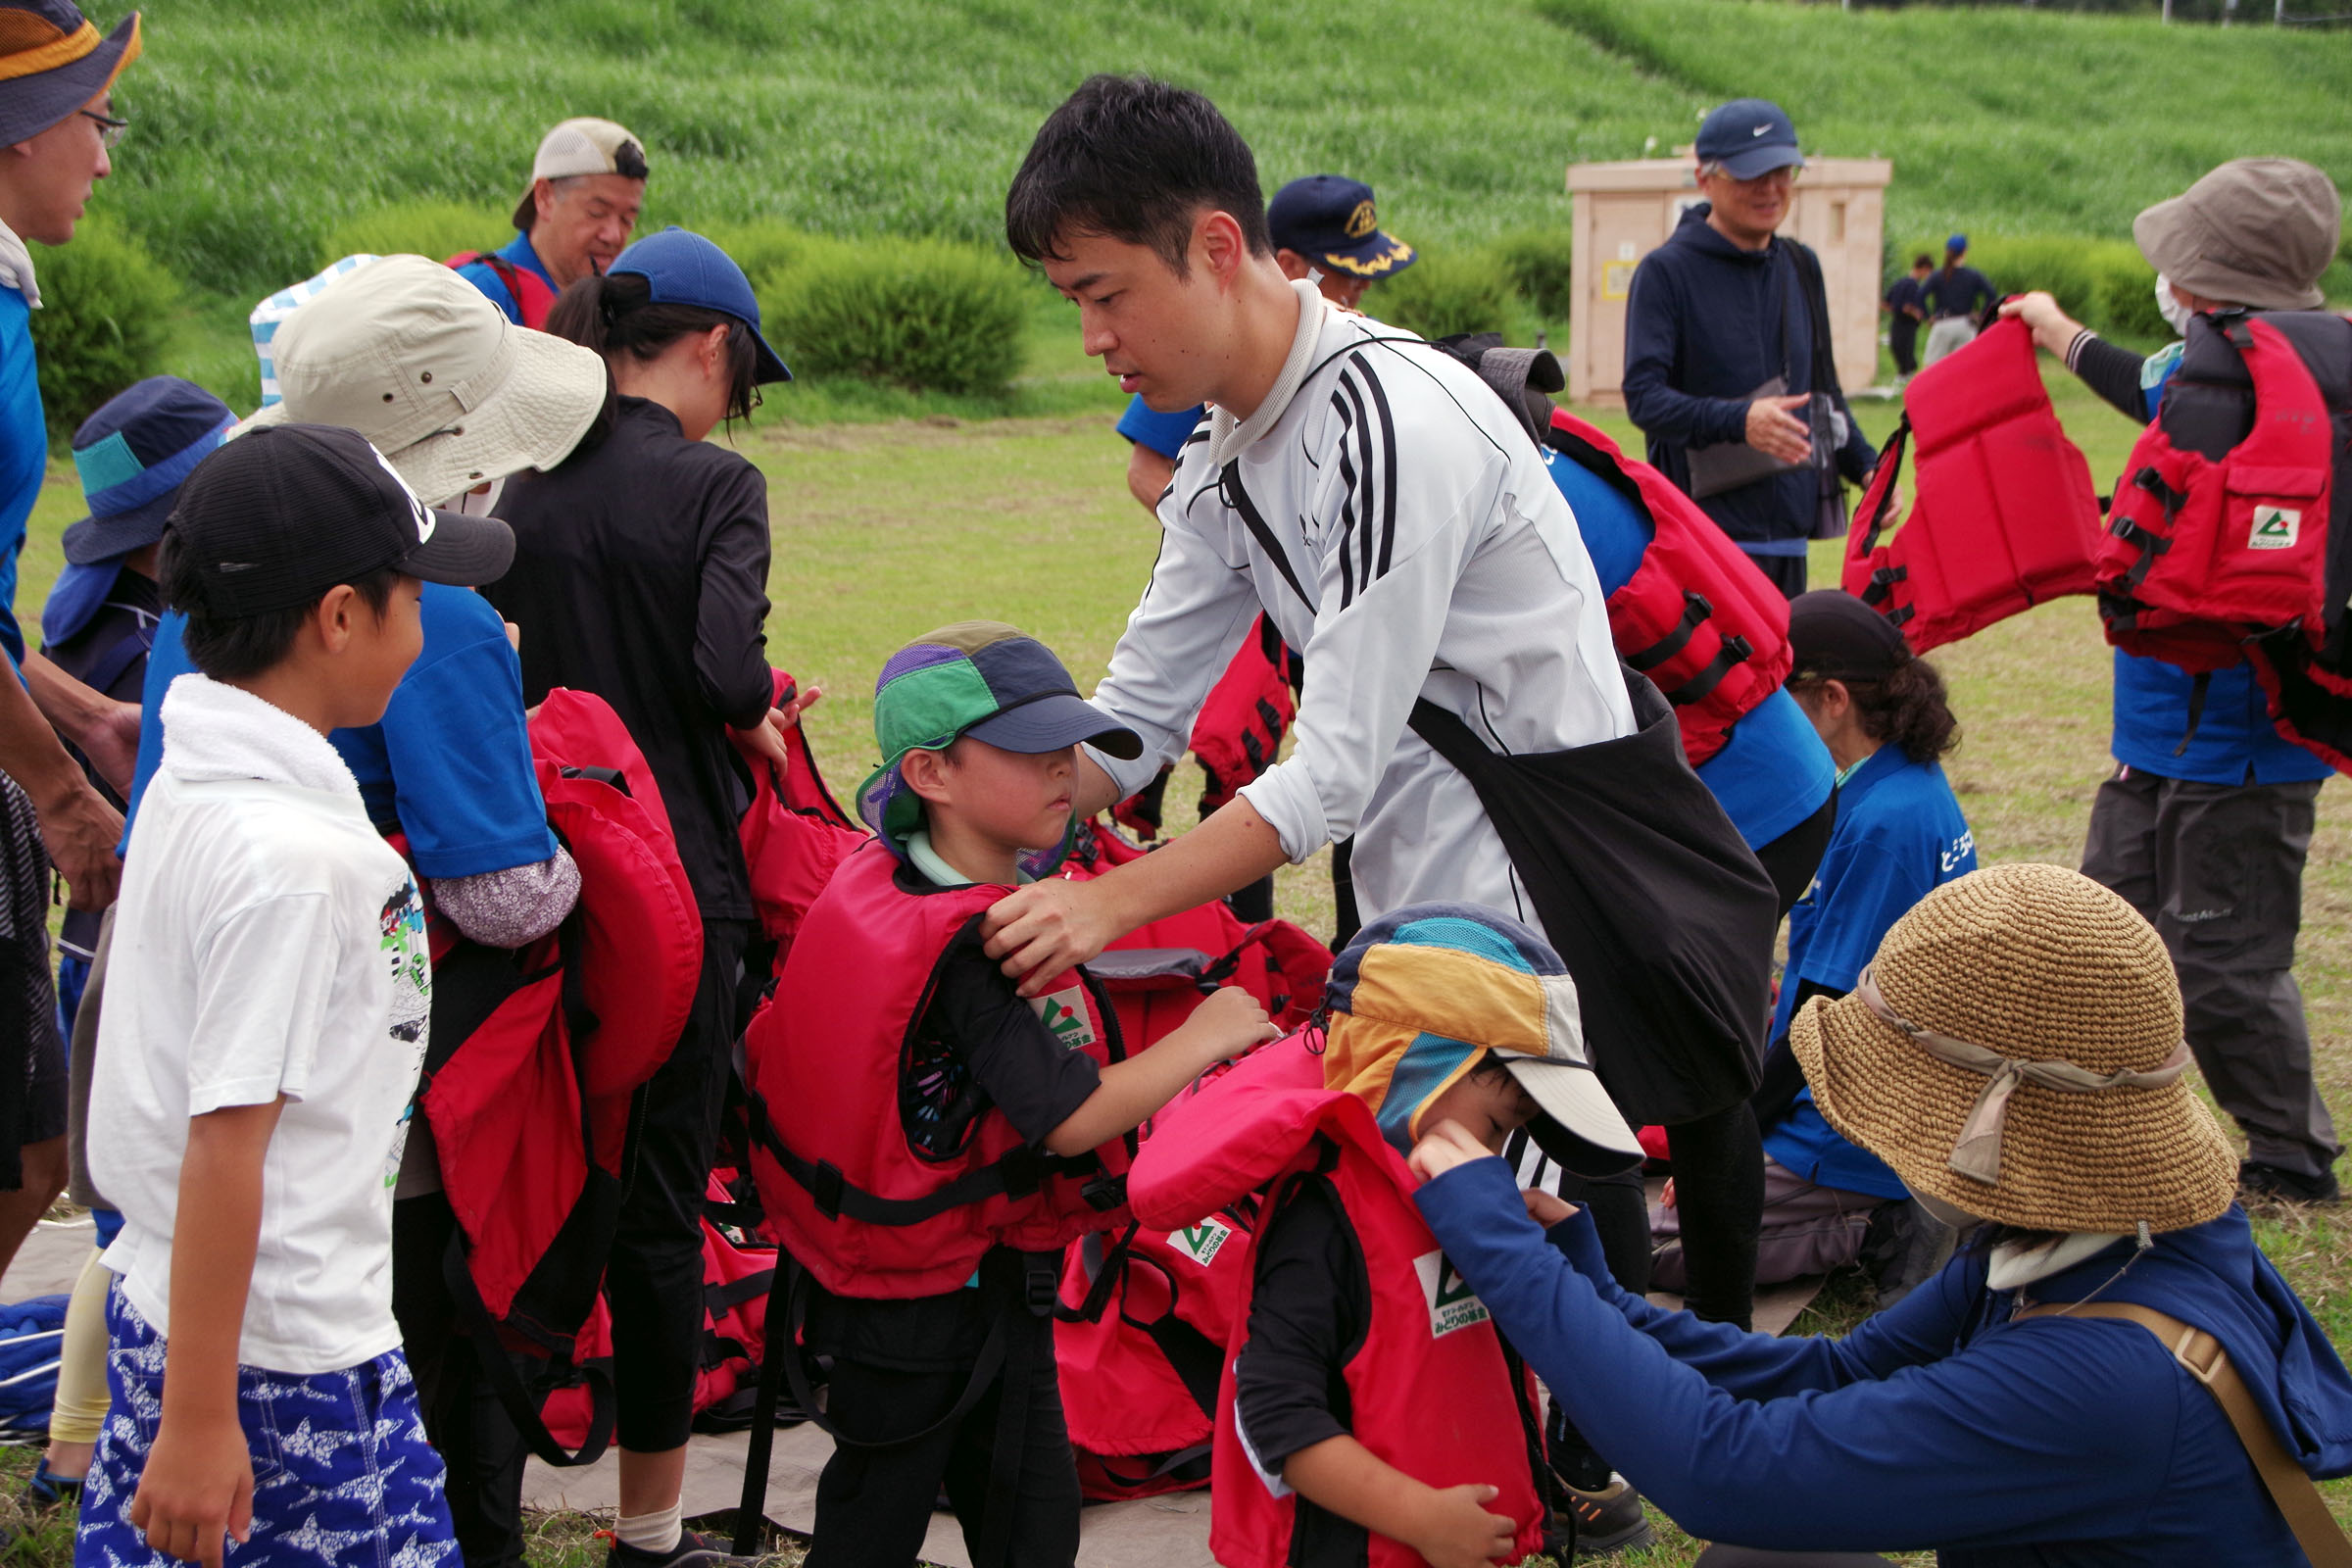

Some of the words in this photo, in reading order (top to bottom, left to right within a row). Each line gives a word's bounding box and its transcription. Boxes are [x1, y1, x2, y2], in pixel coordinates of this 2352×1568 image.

[1201, 1229, 1229, 1264] みどりの基金
[1434, 1304, 1489, 1335] みどりの基金
